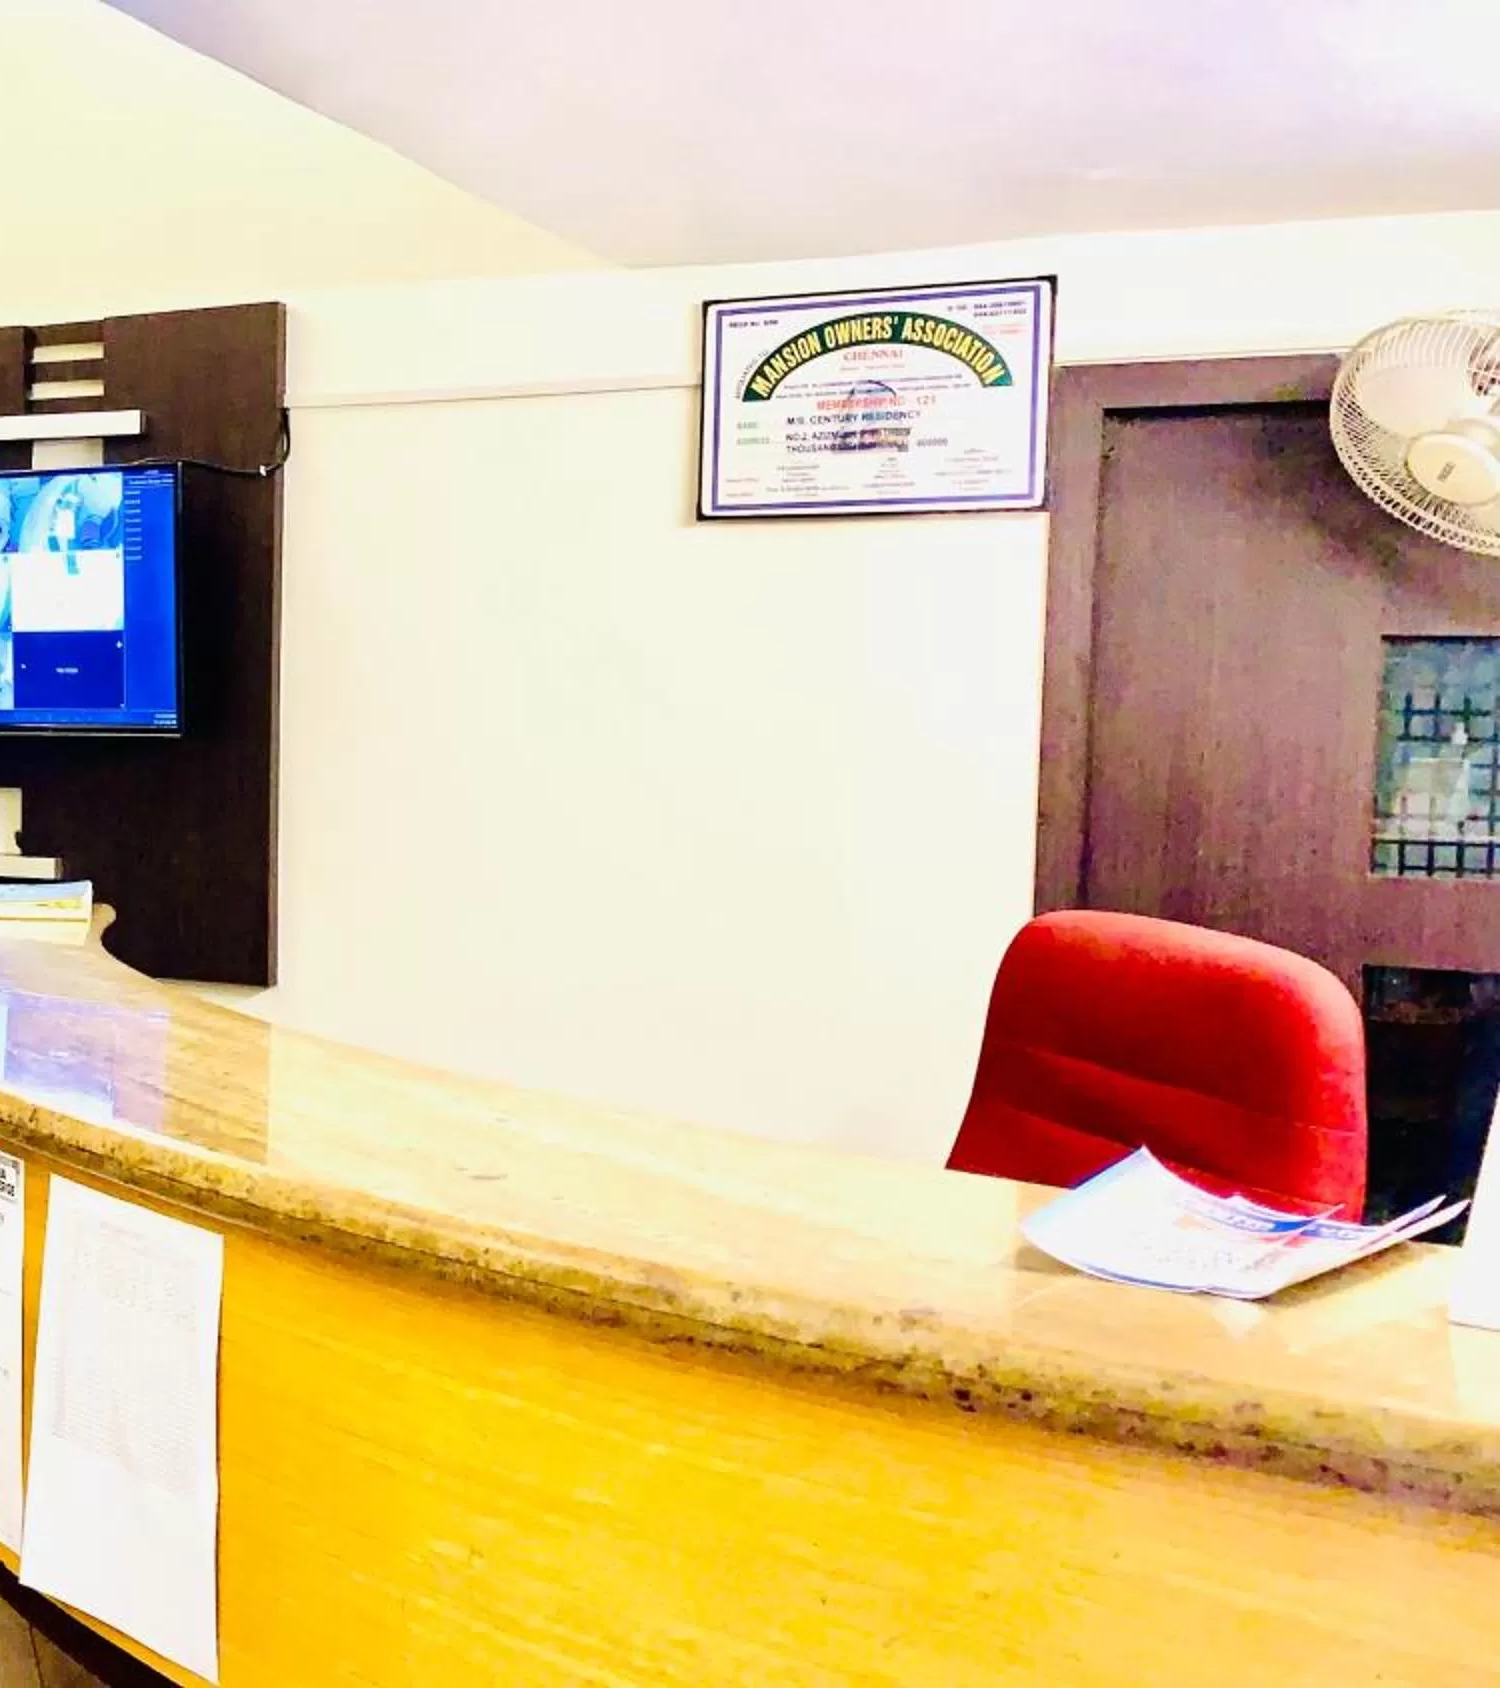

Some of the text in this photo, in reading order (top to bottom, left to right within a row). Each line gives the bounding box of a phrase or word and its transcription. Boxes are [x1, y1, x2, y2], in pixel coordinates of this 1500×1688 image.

[750, 331, 821, 398] MANSION
[824, 315, 899, 348] OWNERS'
[901, 317, 1005, 385] ASSOCIATION
[843, 349, 904, 362] CHENNAI
[809, 412, 858, 425] CENTURY
